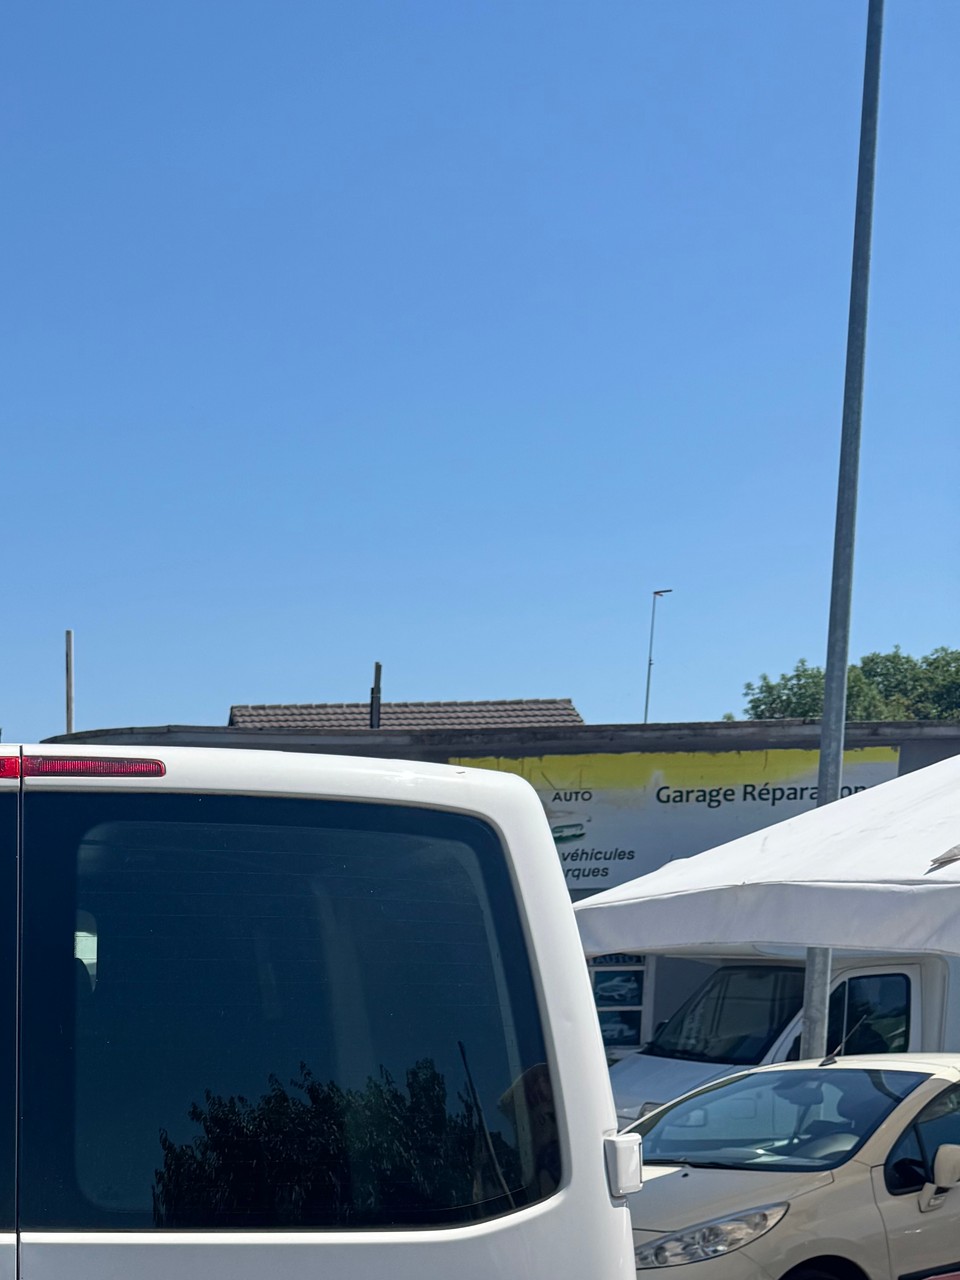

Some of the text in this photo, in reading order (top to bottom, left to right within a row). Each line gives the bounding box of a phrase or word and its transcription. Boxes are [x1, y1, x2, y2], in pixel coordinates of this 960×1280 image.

[552, 791, 592, 802] AUTO
[656, 782, 867, 808] Garage Réparaon
[561, 848, 635, 862] véhicules
